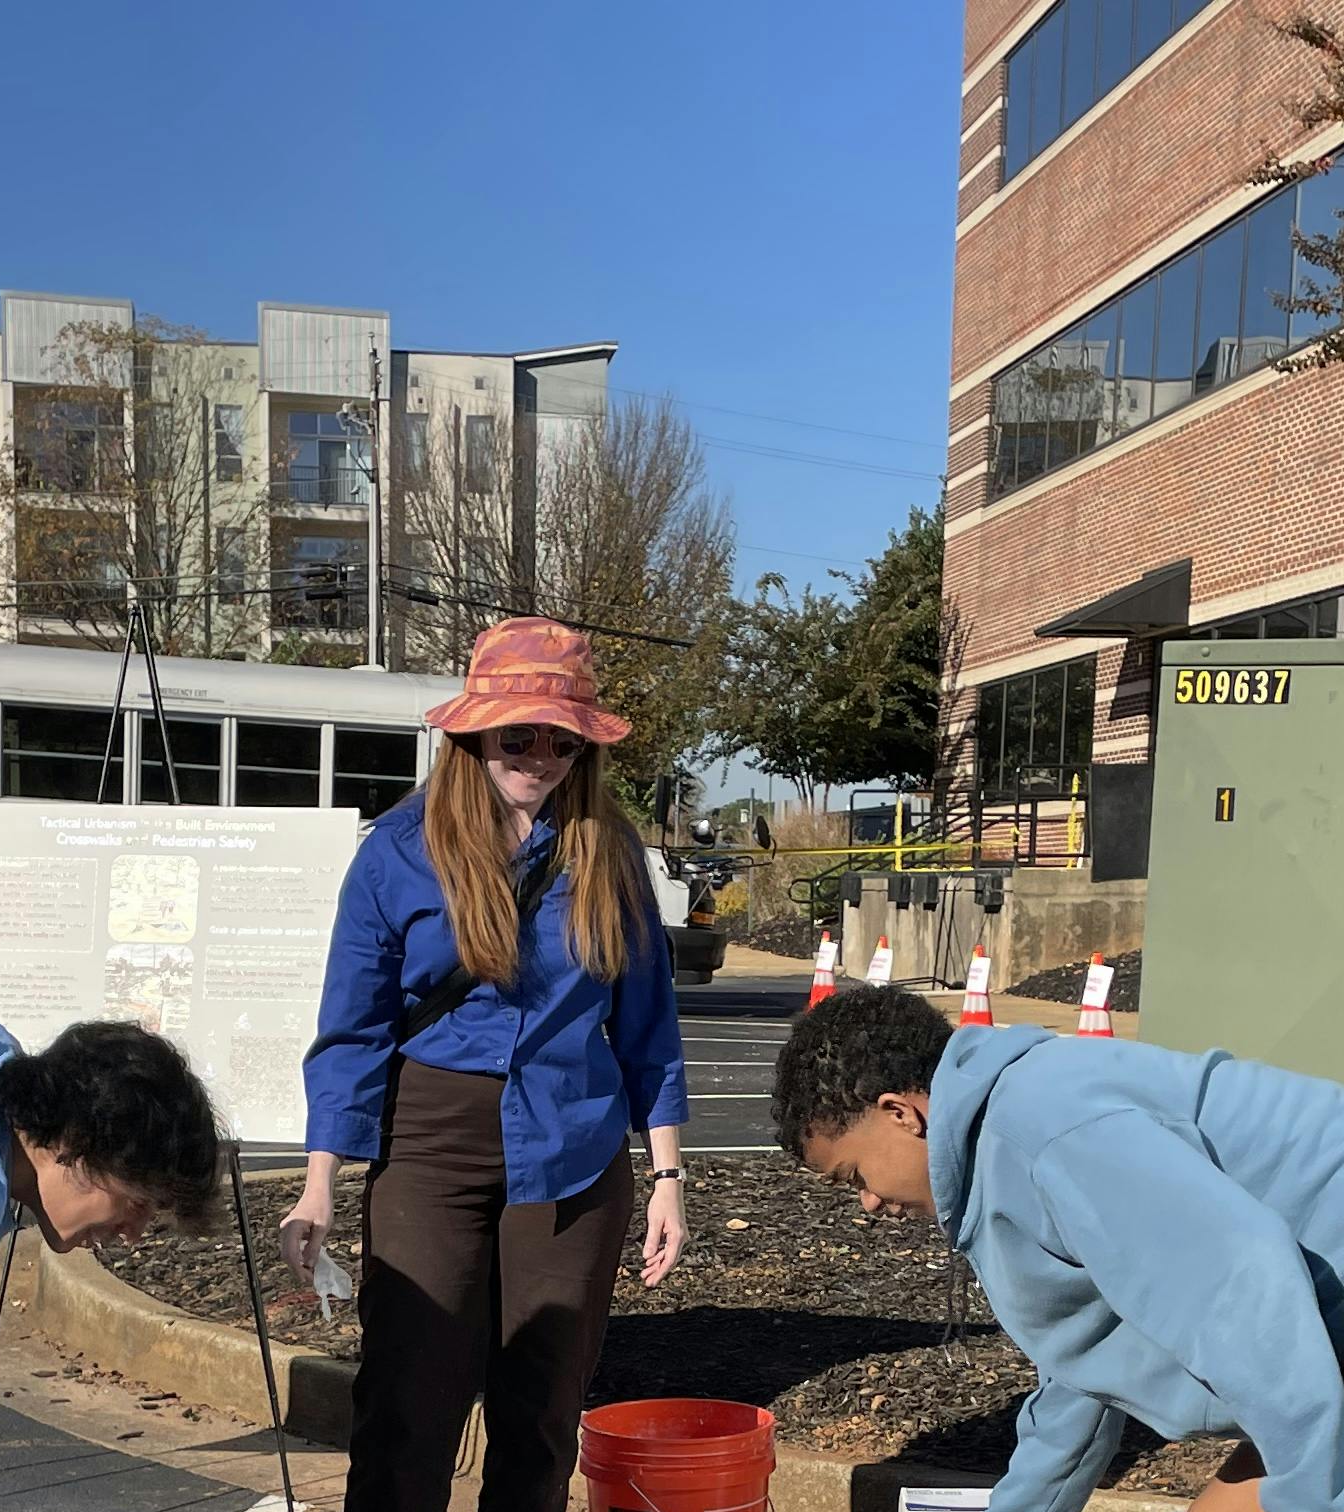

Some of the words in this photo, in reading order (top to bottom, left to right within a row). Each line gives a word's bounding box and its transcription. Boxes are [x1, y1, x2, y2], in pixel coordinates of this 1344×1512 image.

[1176, 670, 1289, 704] 509637
[1219, 789, 1231, 821] 1
[40, 816, 80, 827] Tactical
[85, 817, 136, 827] Urbanism
[175, 817, 201, 828] Built
